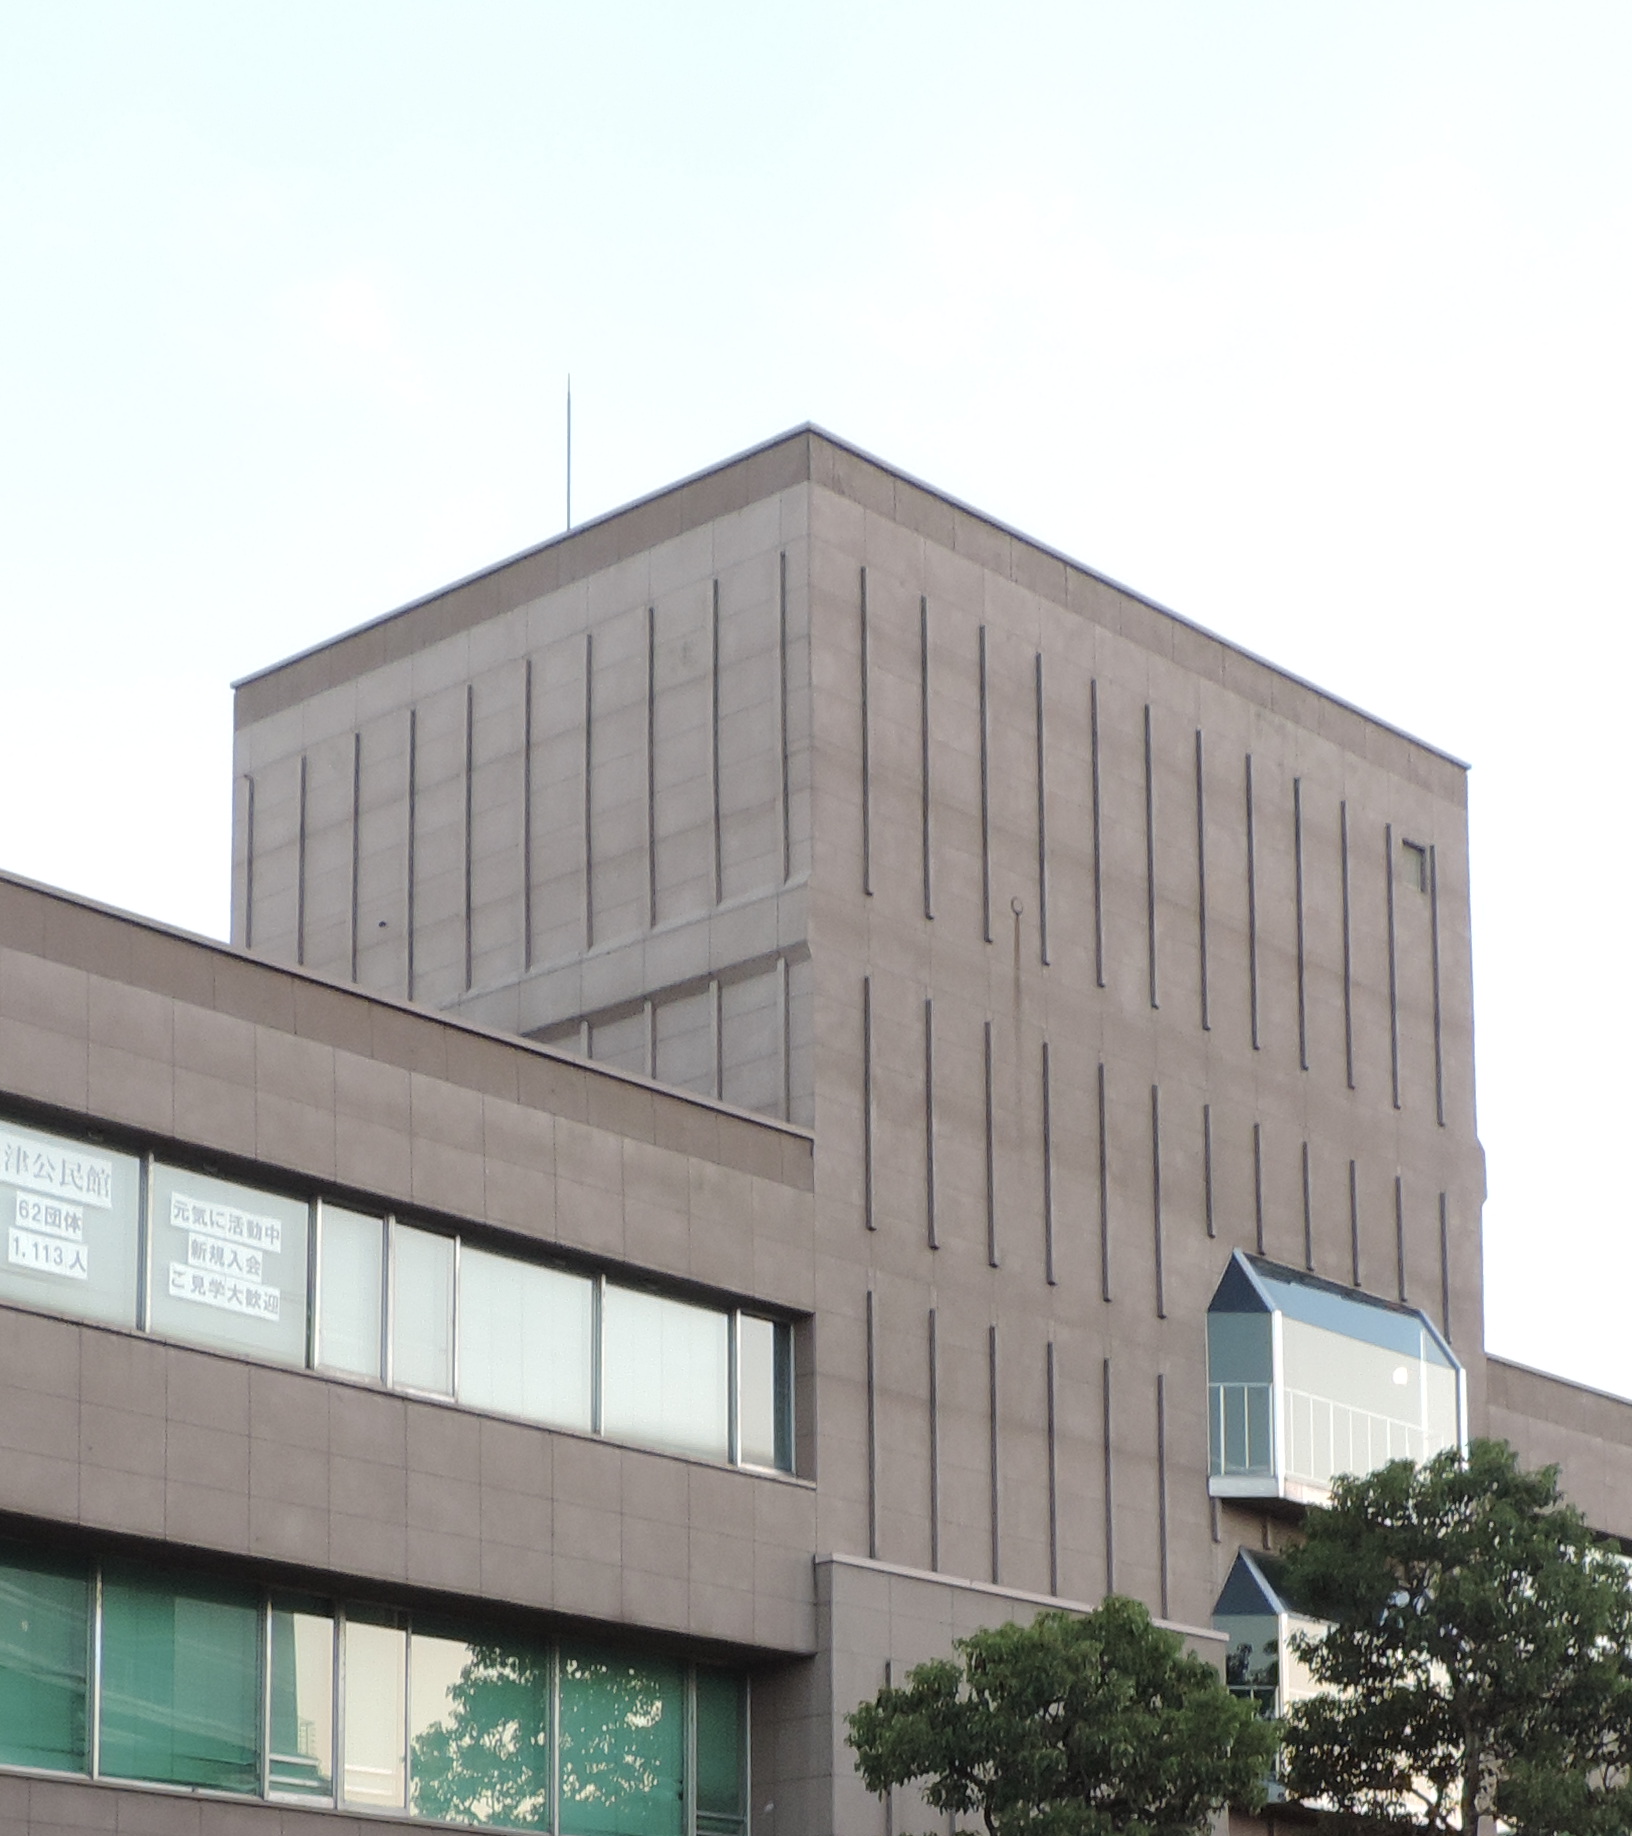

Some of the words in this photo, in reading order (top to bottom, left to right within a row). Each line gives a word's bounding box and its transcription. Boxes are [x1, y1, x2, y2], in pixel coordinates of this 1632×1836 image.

[18, 1199, 82, 1234] 62団体
[173, 1201, 280, 1245] 元気に活動中
[191, 1239, 261, 1276] 新規入会
